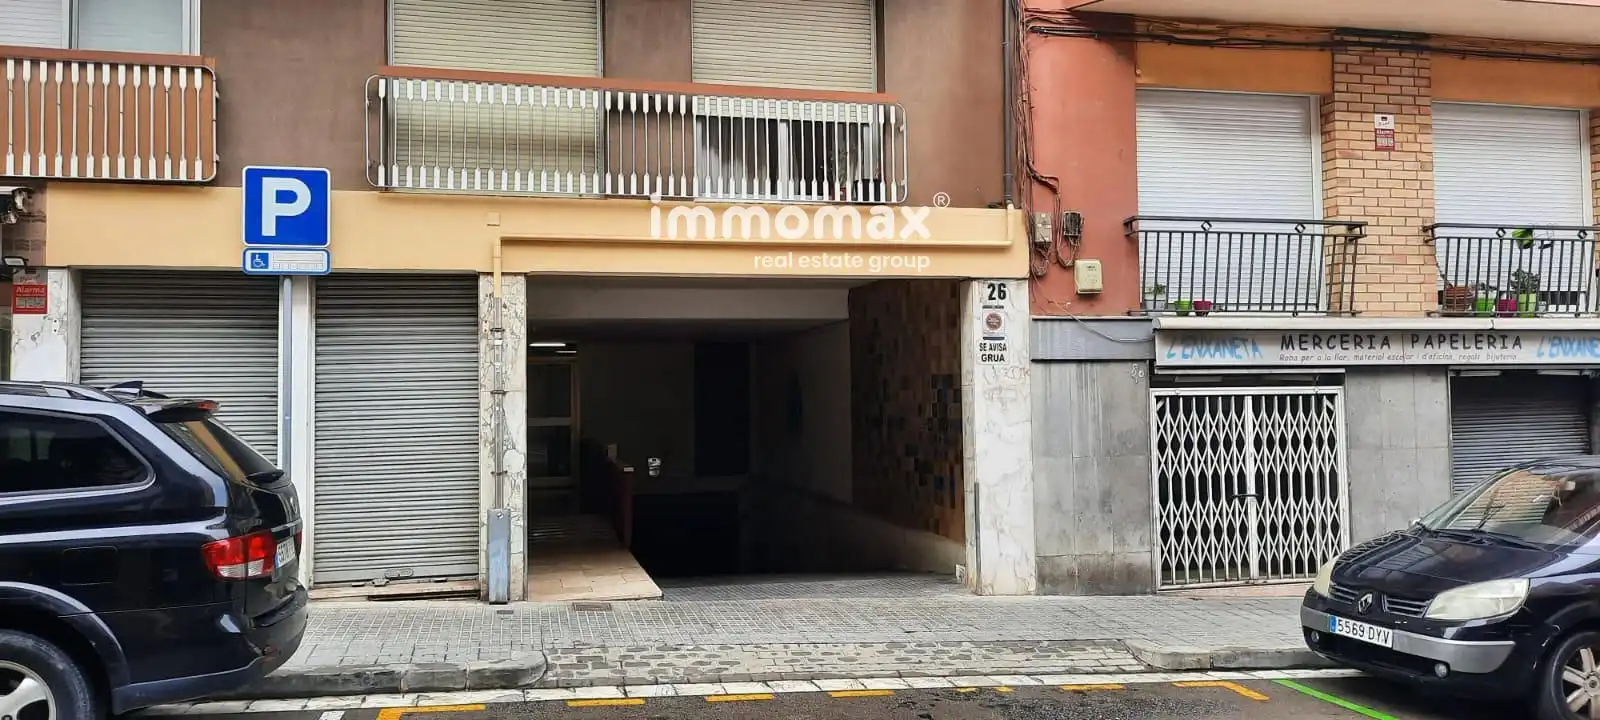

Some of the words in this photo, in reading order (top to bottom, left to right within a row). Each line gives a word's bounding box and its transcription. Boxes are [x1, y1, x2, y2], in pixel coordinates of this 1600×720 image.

[262, 177, 311, 236] P
[987, 283, 1006, 300] 26
[979, 342, 987, 351] SE
[988, 342, 1007, 351] AVISA
[1280, 334, 1391, 350] MERCERIA
[1411, 334, 1522, 350] PAPELERIA
[981, 353, 1005, 362] GRUA
[1301, 355, 1313, 363] per
[1353, 353, 1384, 361] material
[1338, 619, 1365, 638] 5569
[1368, 627, 1389, 645] DYV
